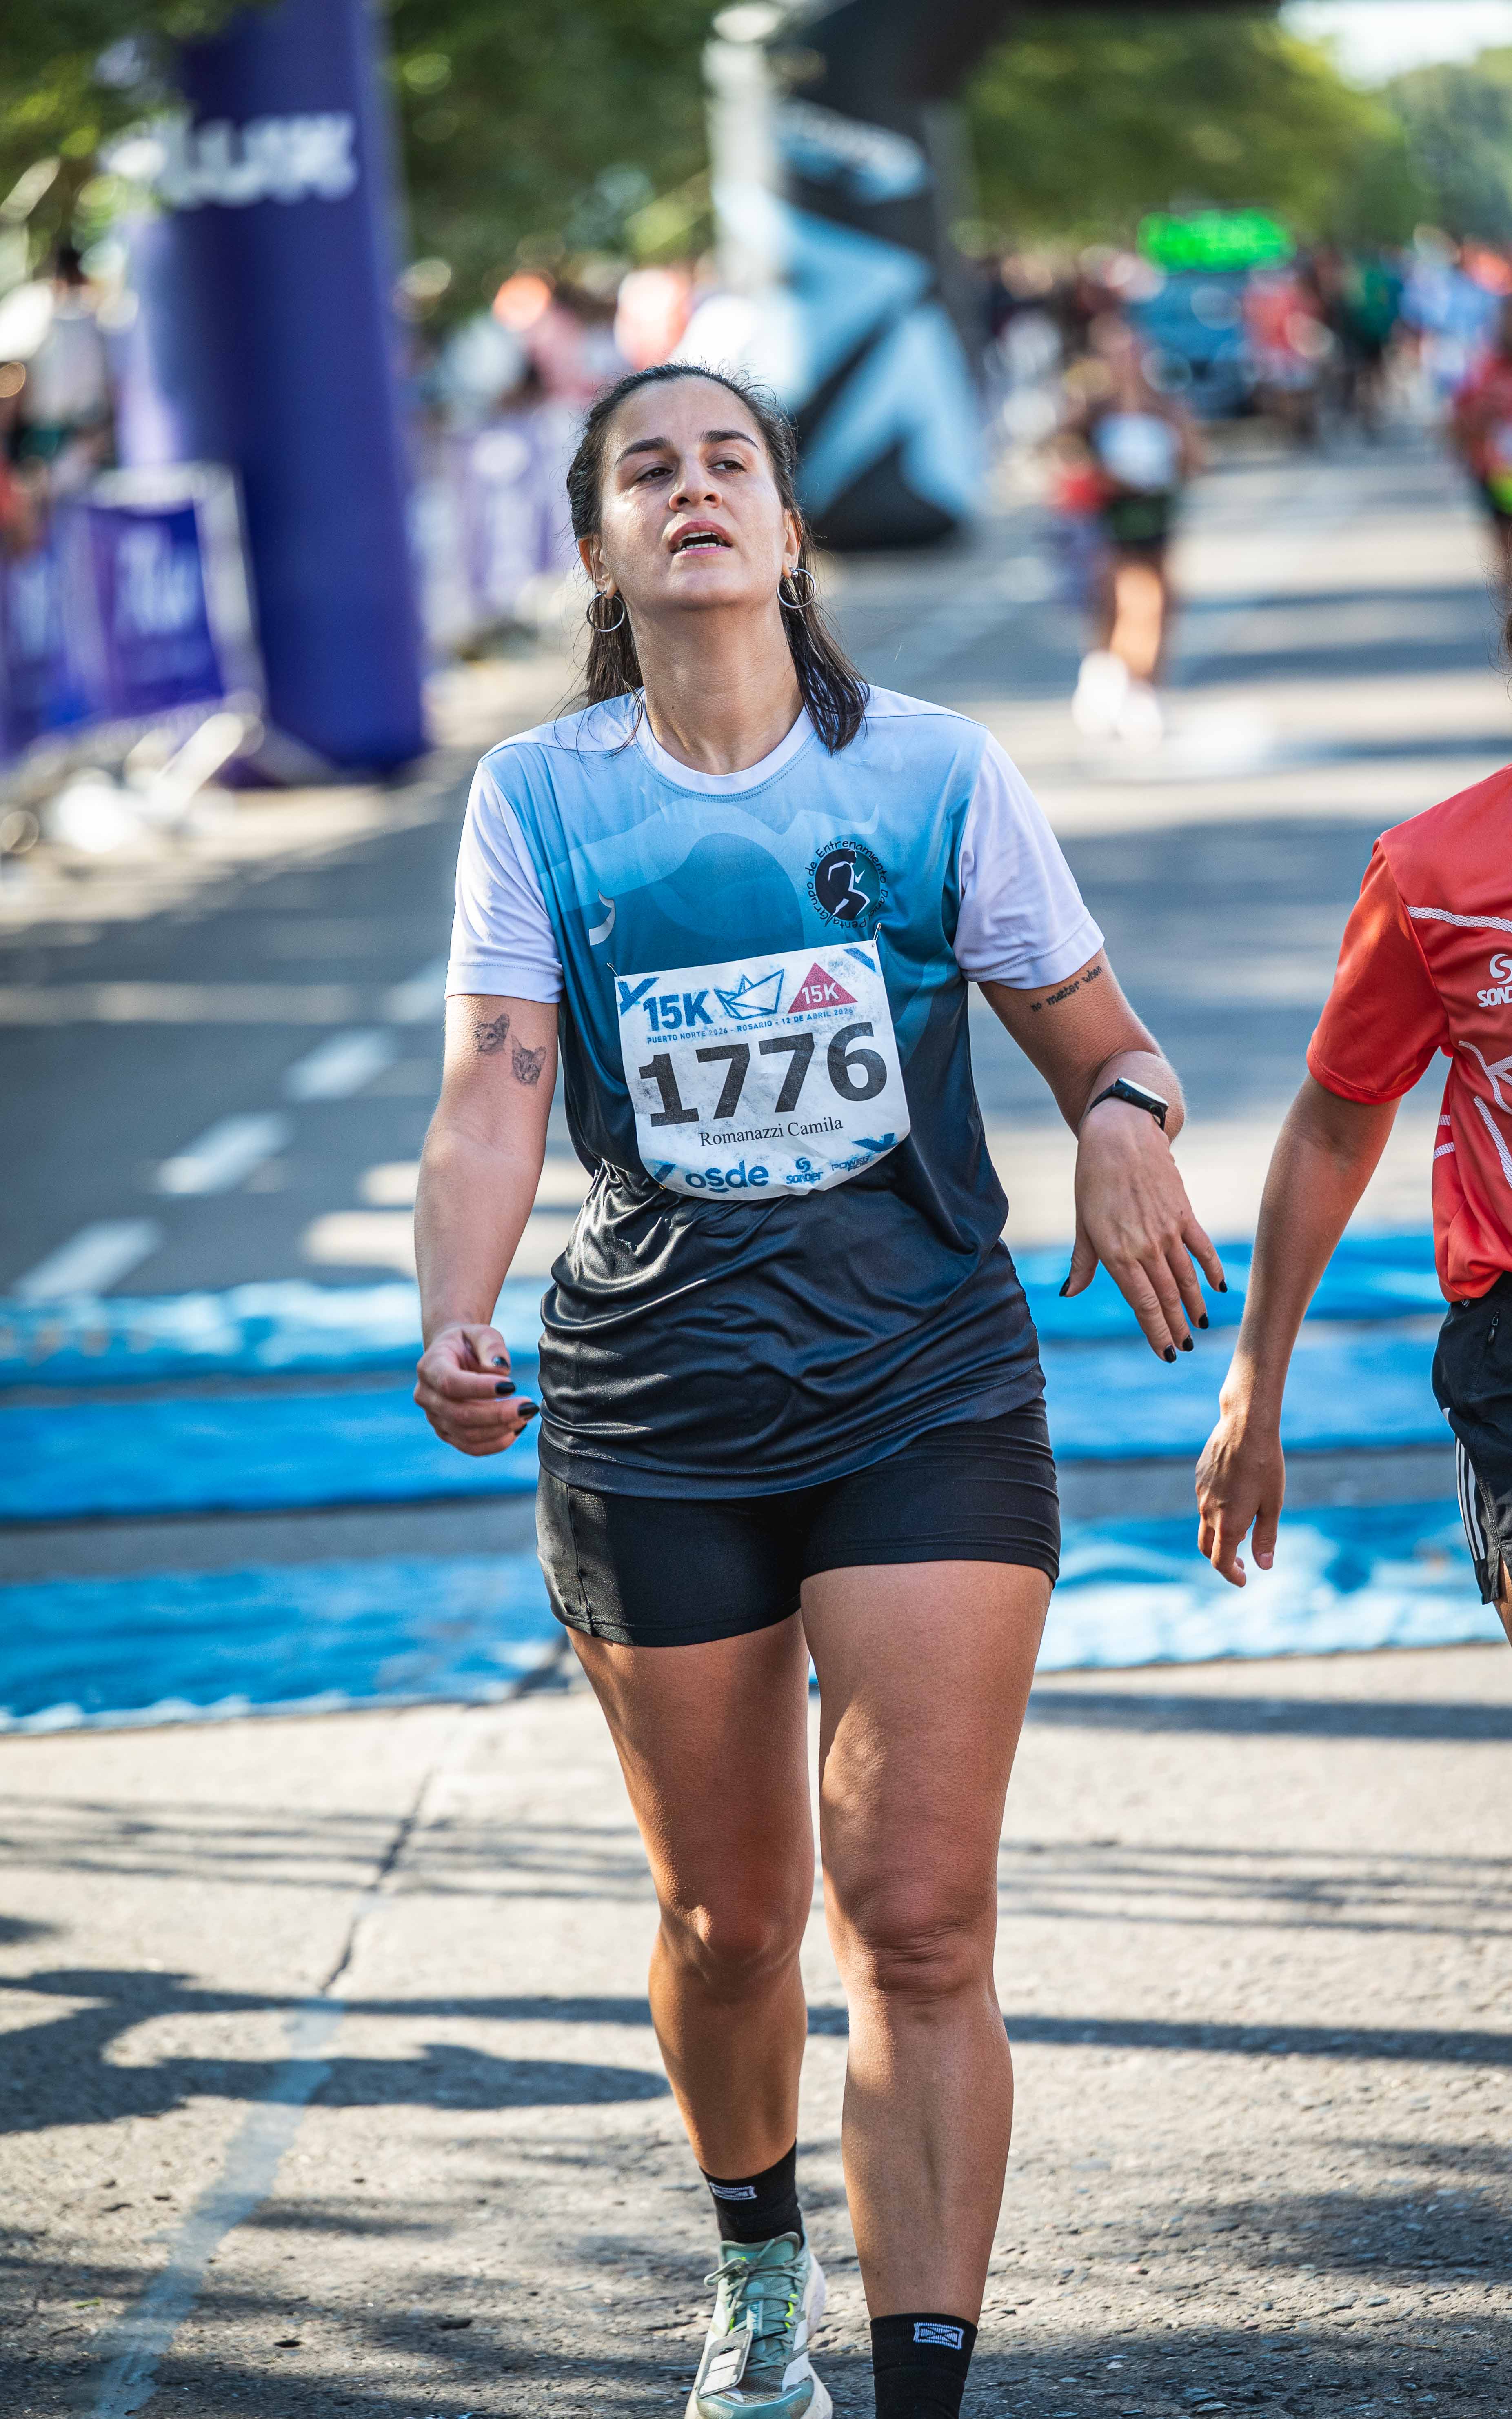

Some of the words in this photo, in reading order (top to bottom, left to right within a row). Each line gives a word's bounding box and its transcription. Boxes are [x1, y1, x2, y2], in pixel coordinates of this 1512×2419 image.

[805, 861, 817, 876] de
[816, 841, 887, 883] Entrenamiento
[807, 882, 829, 920] Grupo
[868, 889, 888, 922] Daniel
[833, 918, 866, 929] Penta
[802, 982, 840, 1005] 15K
[1046, 980, 1080, 1006] matter
[643, 991, 714, 1031] 15K
[647, 1034, 678, 1044] PUERTO
[680, 1031, 706, 1040] NORTE
[708, 1027, 728, 1036] 2026
[737, 1020, 773, 1032] ROSARIO
[807, 1011, 831, 1021] ABRIL
[834, 1006, 854, 1016] 2026
[638, 1022, 887, 1128] 1776
[699, 1125, 784, 1147] Romanazzi
[787, 1117, 844, 1137] Camila
[686, 1160, 769, 1193] osde
